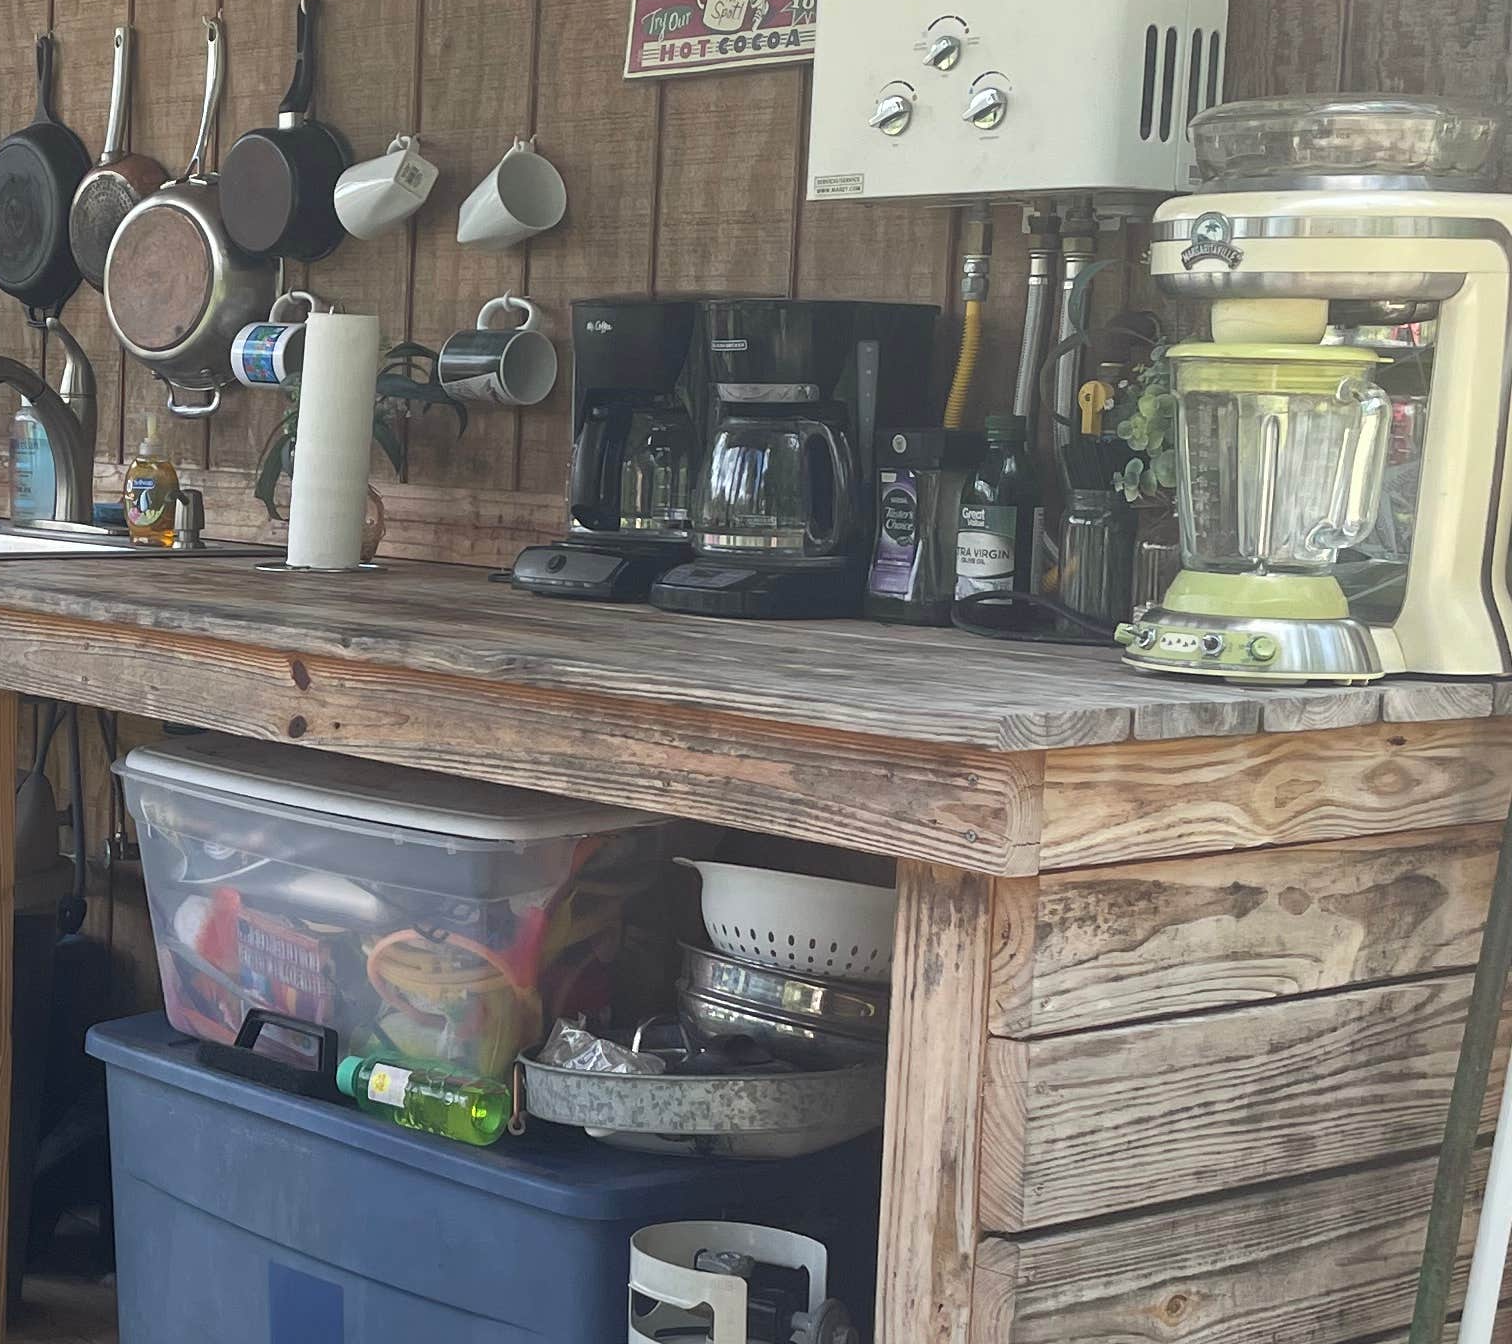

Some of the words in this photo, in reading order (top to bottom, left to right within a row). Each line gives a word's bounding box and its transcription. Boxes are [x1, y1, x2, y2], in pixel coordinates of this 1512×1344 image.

[641, 7, 668, 42] Try
[668, 11, 691, 31] Our
[659, 39, 710, 62] HOT
[717, 28, 801, 55] COCOA
[962, 506, 986, 521] Great
[974, 547, 1010, 561] VIRGIN
